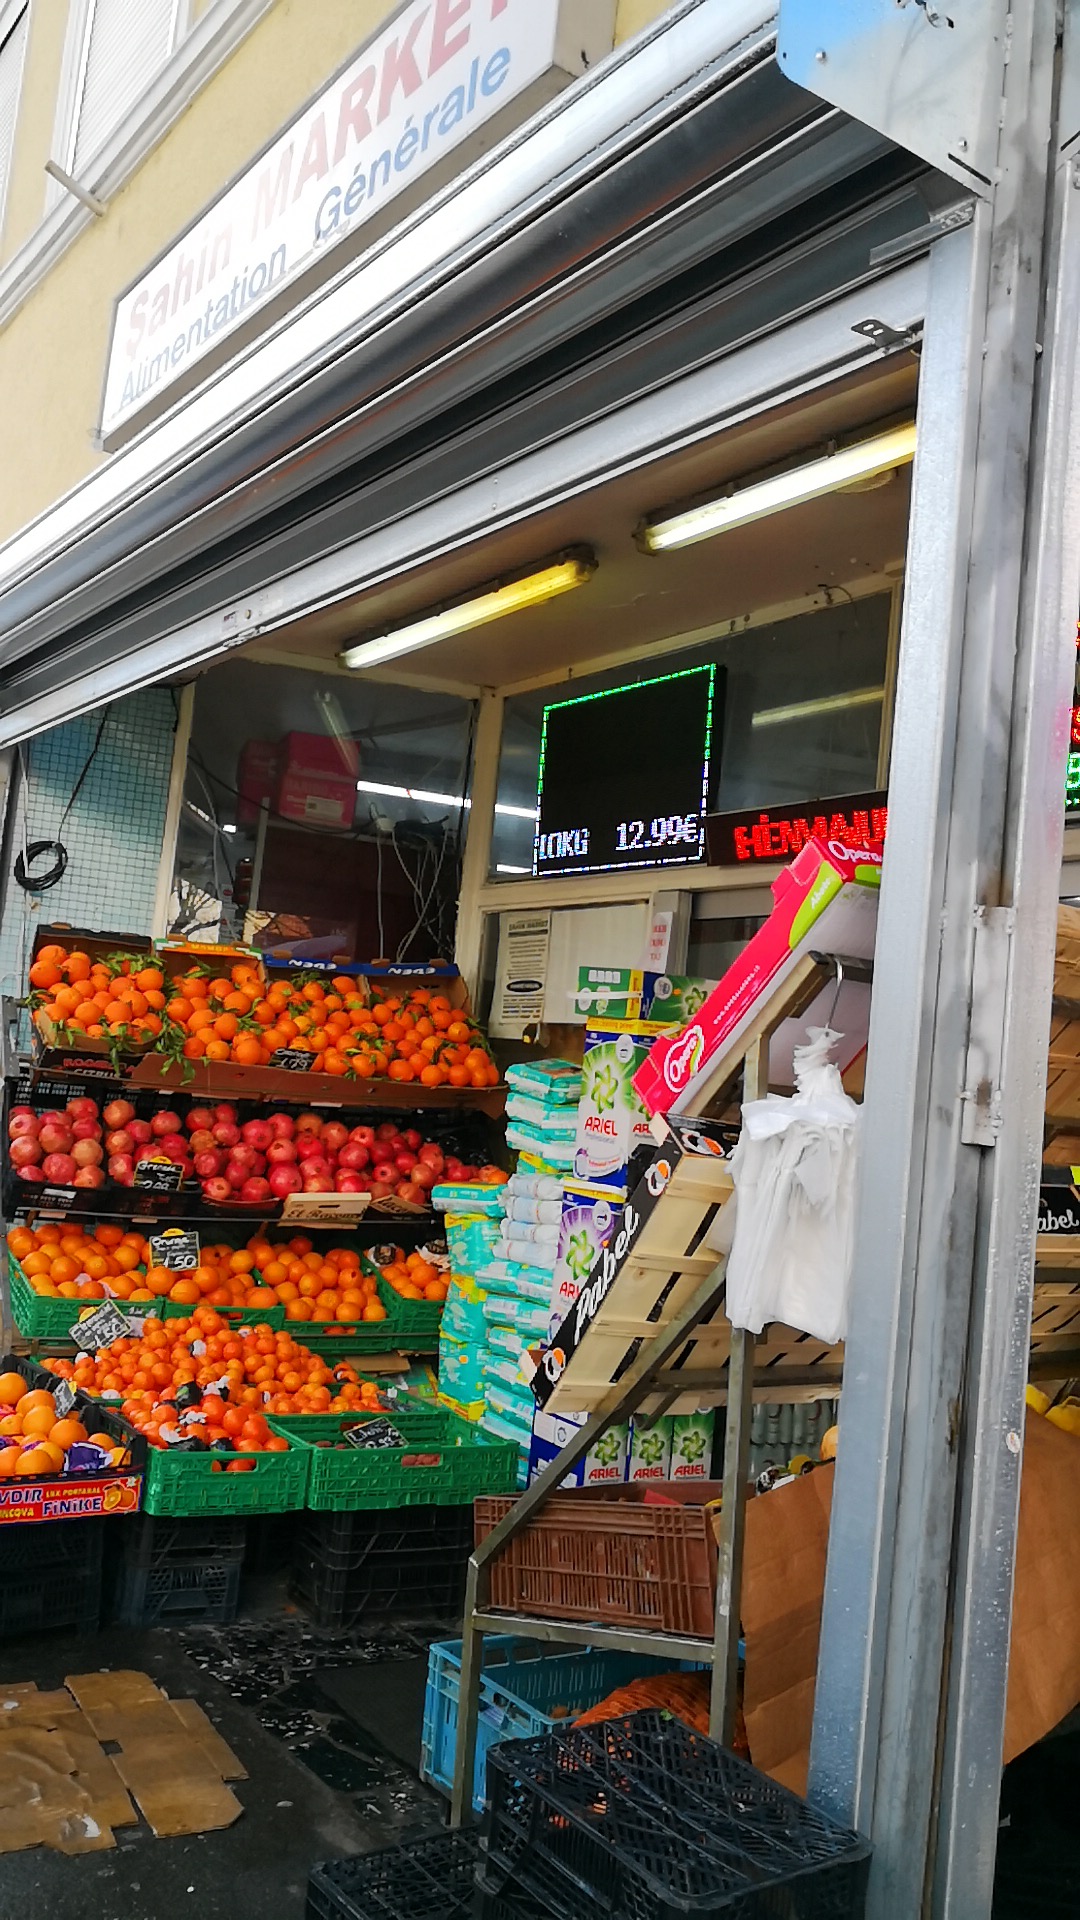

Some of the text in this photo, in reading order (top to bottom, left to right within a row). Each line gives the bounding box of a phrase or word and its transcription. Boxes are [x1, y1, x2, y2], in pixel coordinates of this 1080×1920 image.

[118, 47, 511, 411] Alimentation Générale
[584, 1116, 618, 1136] ARIEL
[1037, 1208, 1080, 1231] abel
[588, 1467, 621, 1480] ARIEL
[633, 1467, 665, 1479] ARIEL
[674, 1464, 706, 1476] ARIEL
